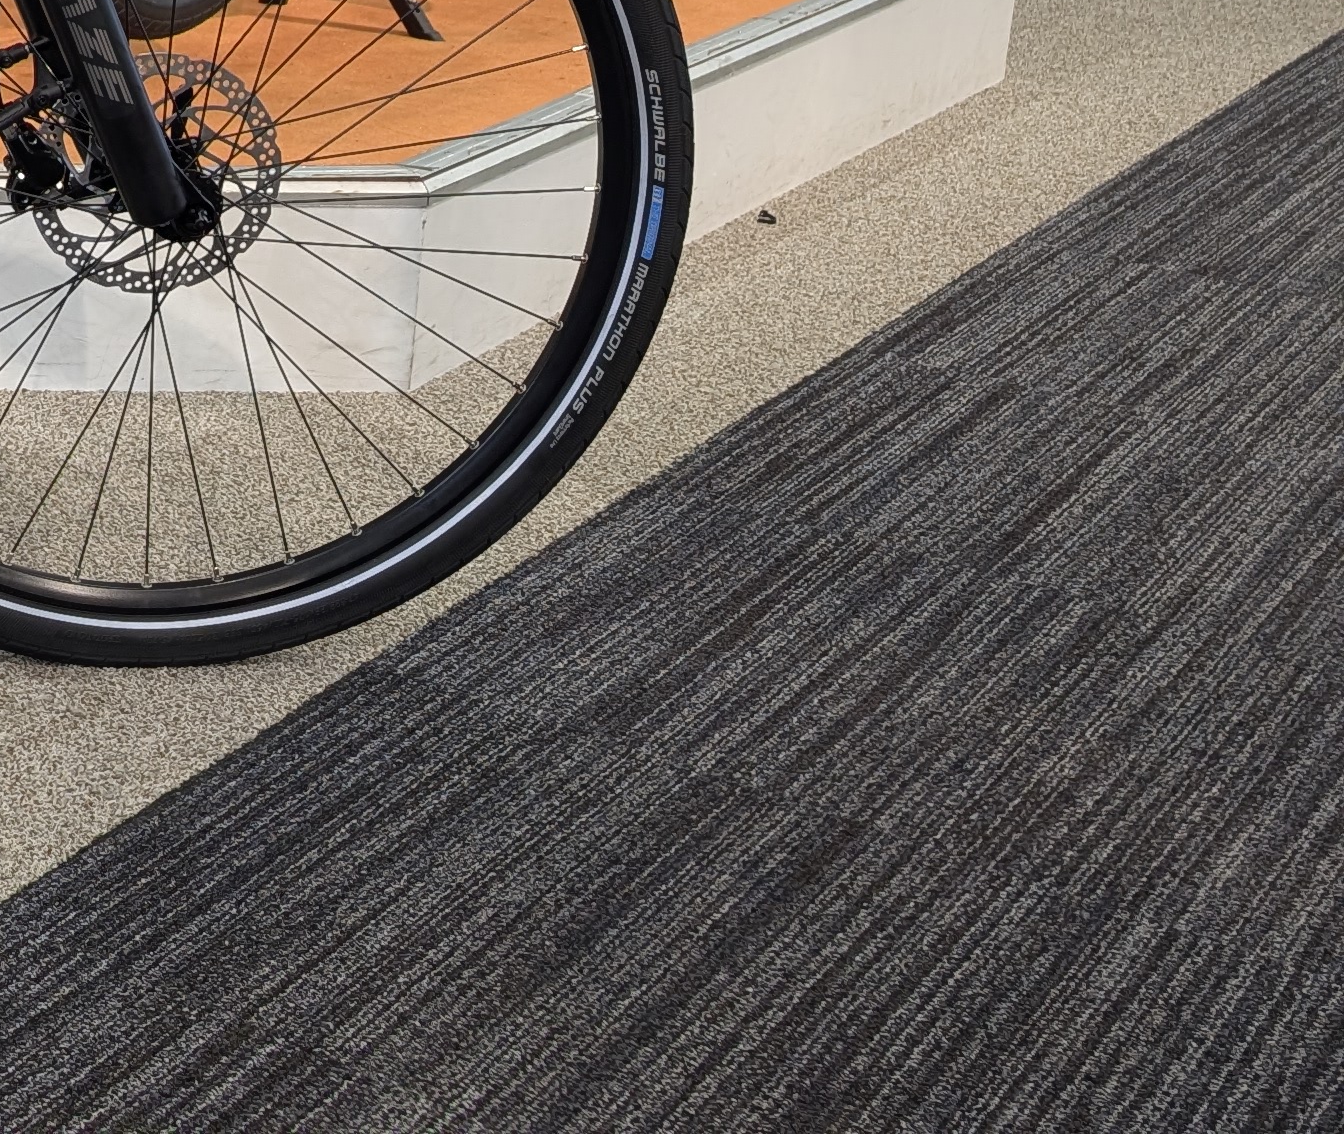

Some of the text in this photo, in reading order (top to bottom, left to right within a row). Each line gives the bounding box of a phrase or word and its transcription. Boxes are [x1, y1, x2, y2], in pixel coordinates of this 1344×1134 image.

[645, 68, 665, 183] SCHWALBE
[602, 262, 650, 362] MARATHON
[572, 364, 605, 416] PLUS
